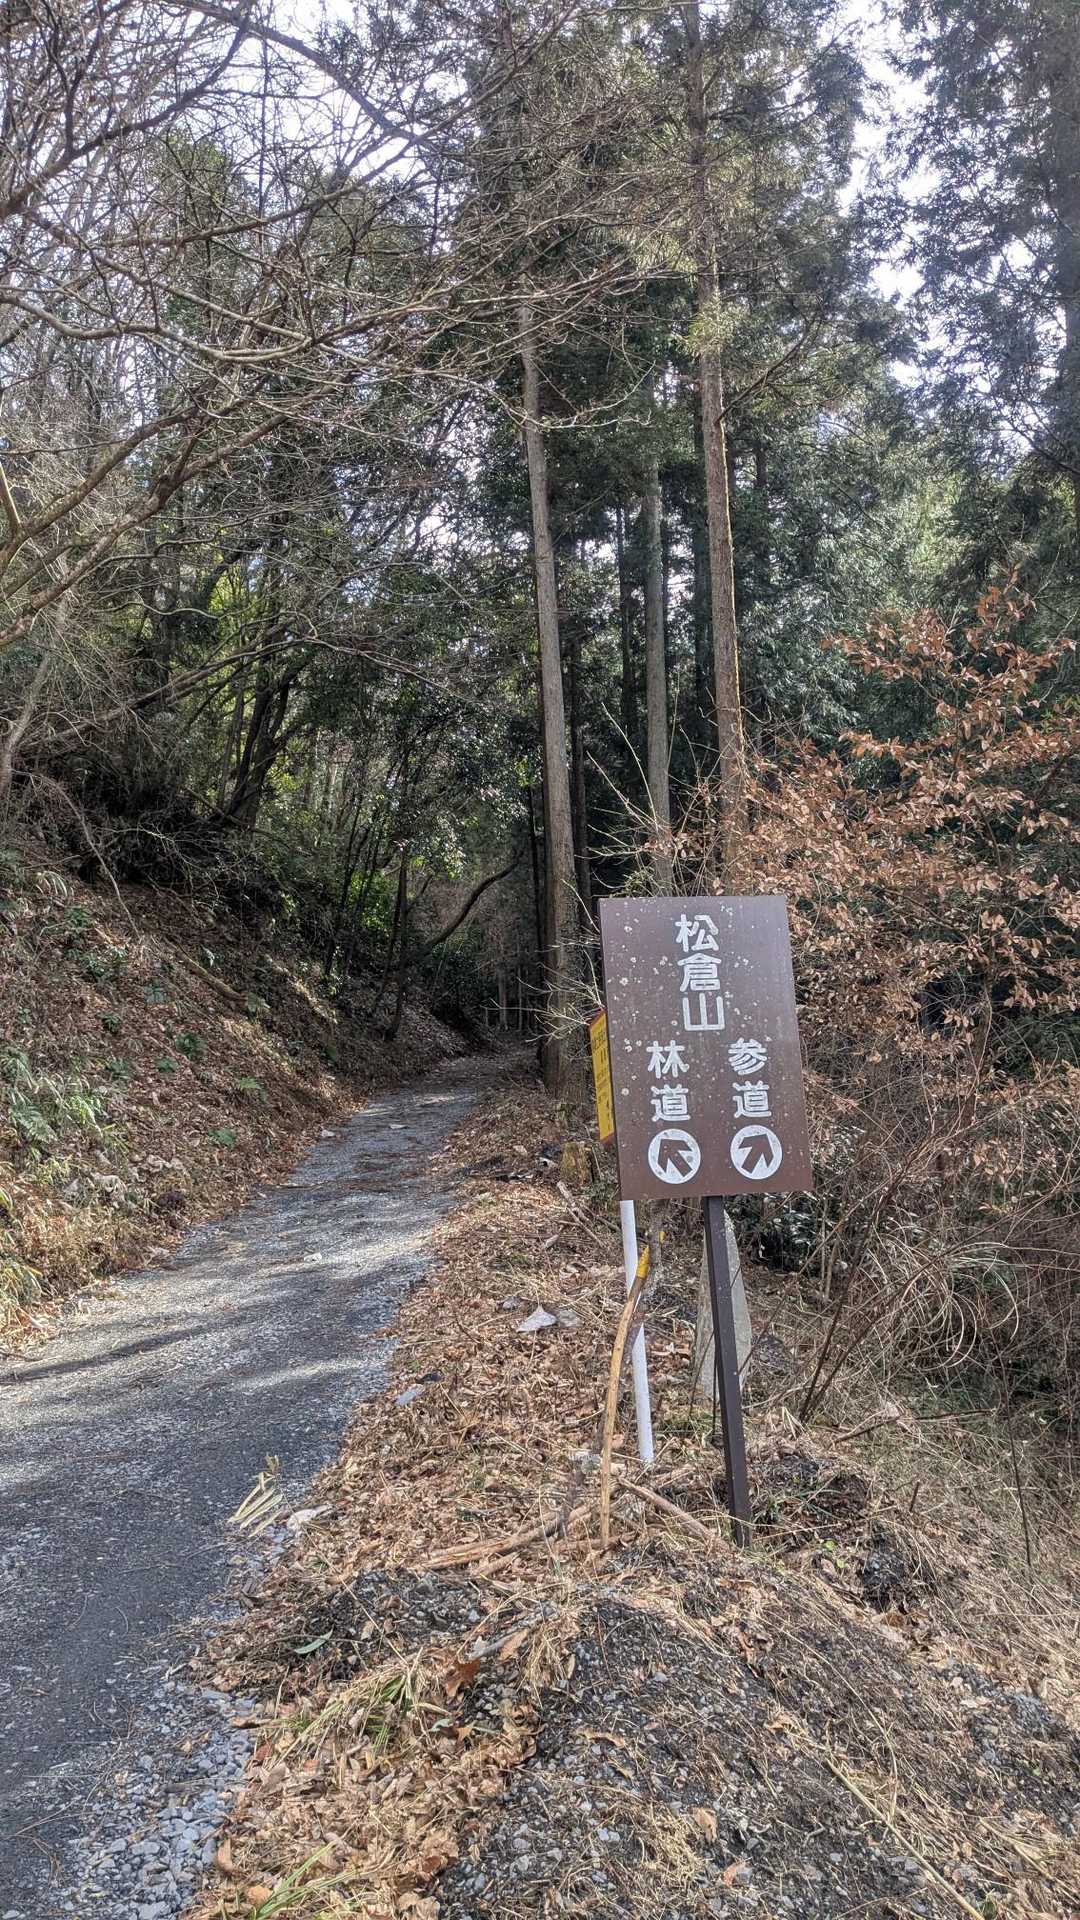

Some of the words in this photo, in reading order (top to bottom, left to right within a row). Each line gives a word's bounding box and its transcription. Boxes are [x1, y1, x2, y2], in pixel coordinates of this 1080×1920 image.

[675, 913, 726, 1032] 松倉山
[646, 1039, 692, 1122] 林道
[727, 1037, 772, 1119] 参道
